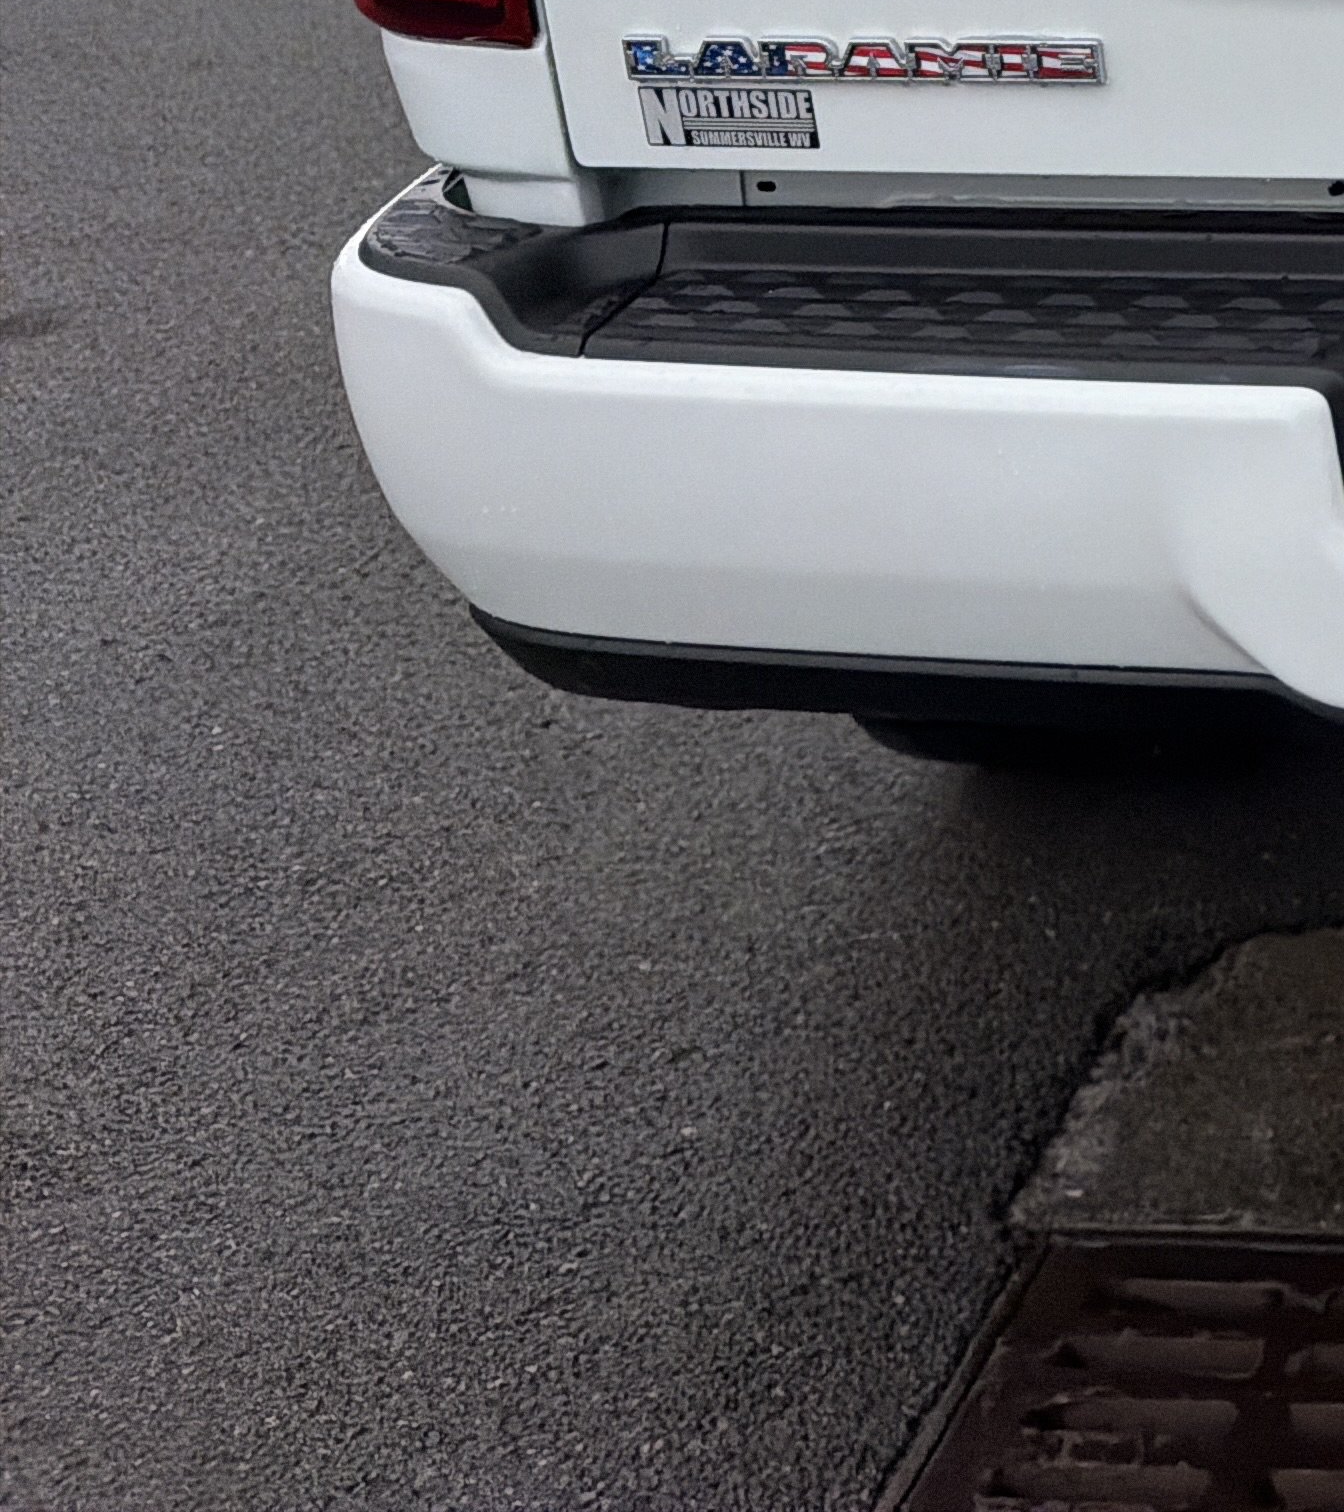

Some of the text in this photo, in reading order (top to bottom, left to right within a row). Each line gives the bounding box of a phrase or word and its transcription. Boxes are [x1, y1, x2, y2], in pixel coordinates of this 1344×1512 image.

[621, 33, 1106, 85] LARAMIE
[638, 88, 812, 145] NORTHSIDE
[690, 130, 811, 148] SUMMERSVILLE WV
